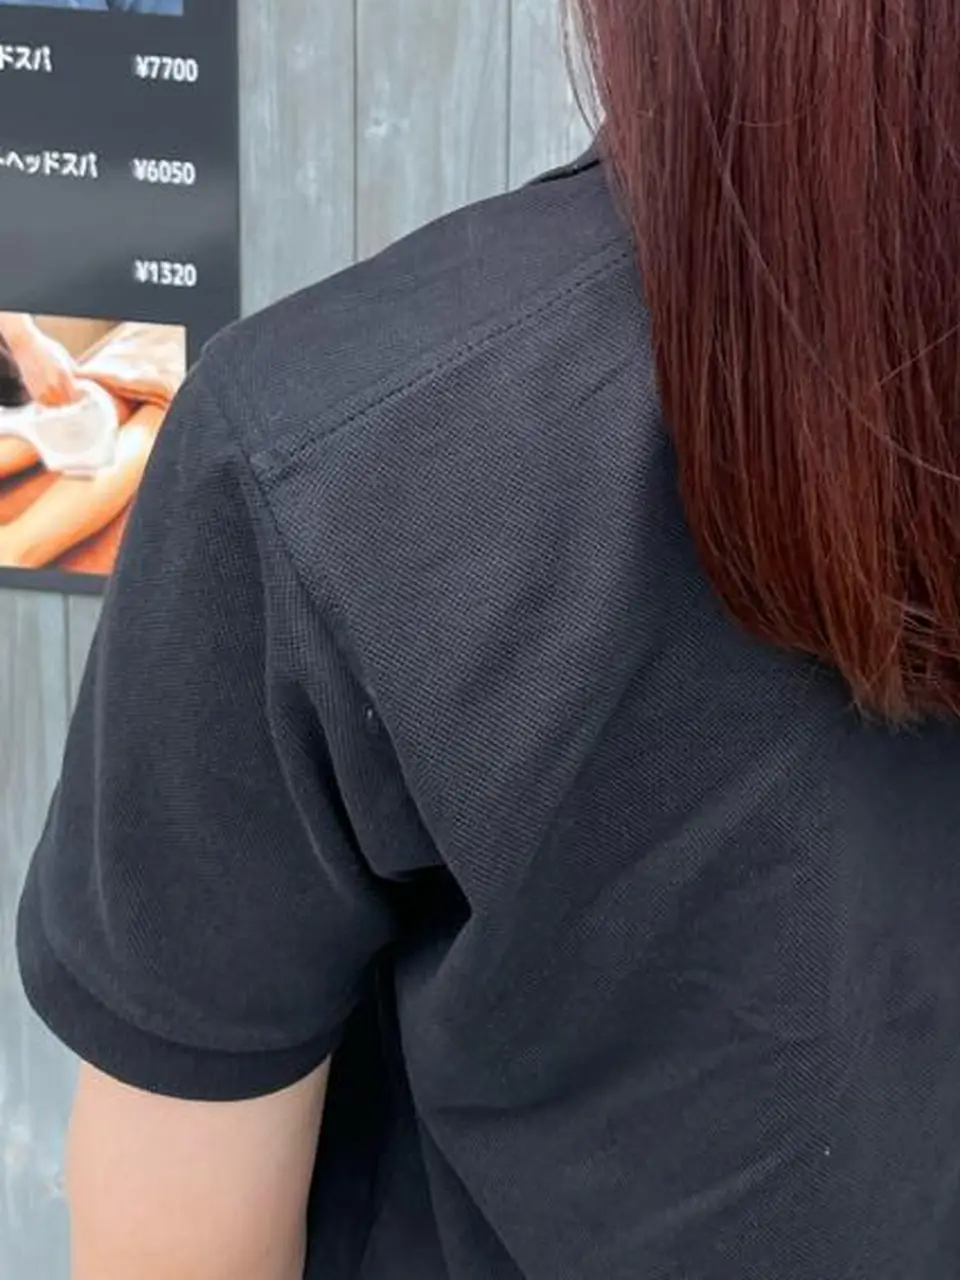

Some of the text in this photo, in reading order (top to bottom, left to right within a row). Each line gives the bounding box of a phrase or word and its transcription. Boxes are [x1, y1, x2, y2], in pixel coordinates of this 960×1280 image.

[0, 45, 53, 73] ドスパ
[134, 54, 199, 81] ¥7700
[0, 151, 98, 179] ヘッドスパ
[133, 158, 196, 185] ¥6050
[134, 260, 197, 287] ¥1320
